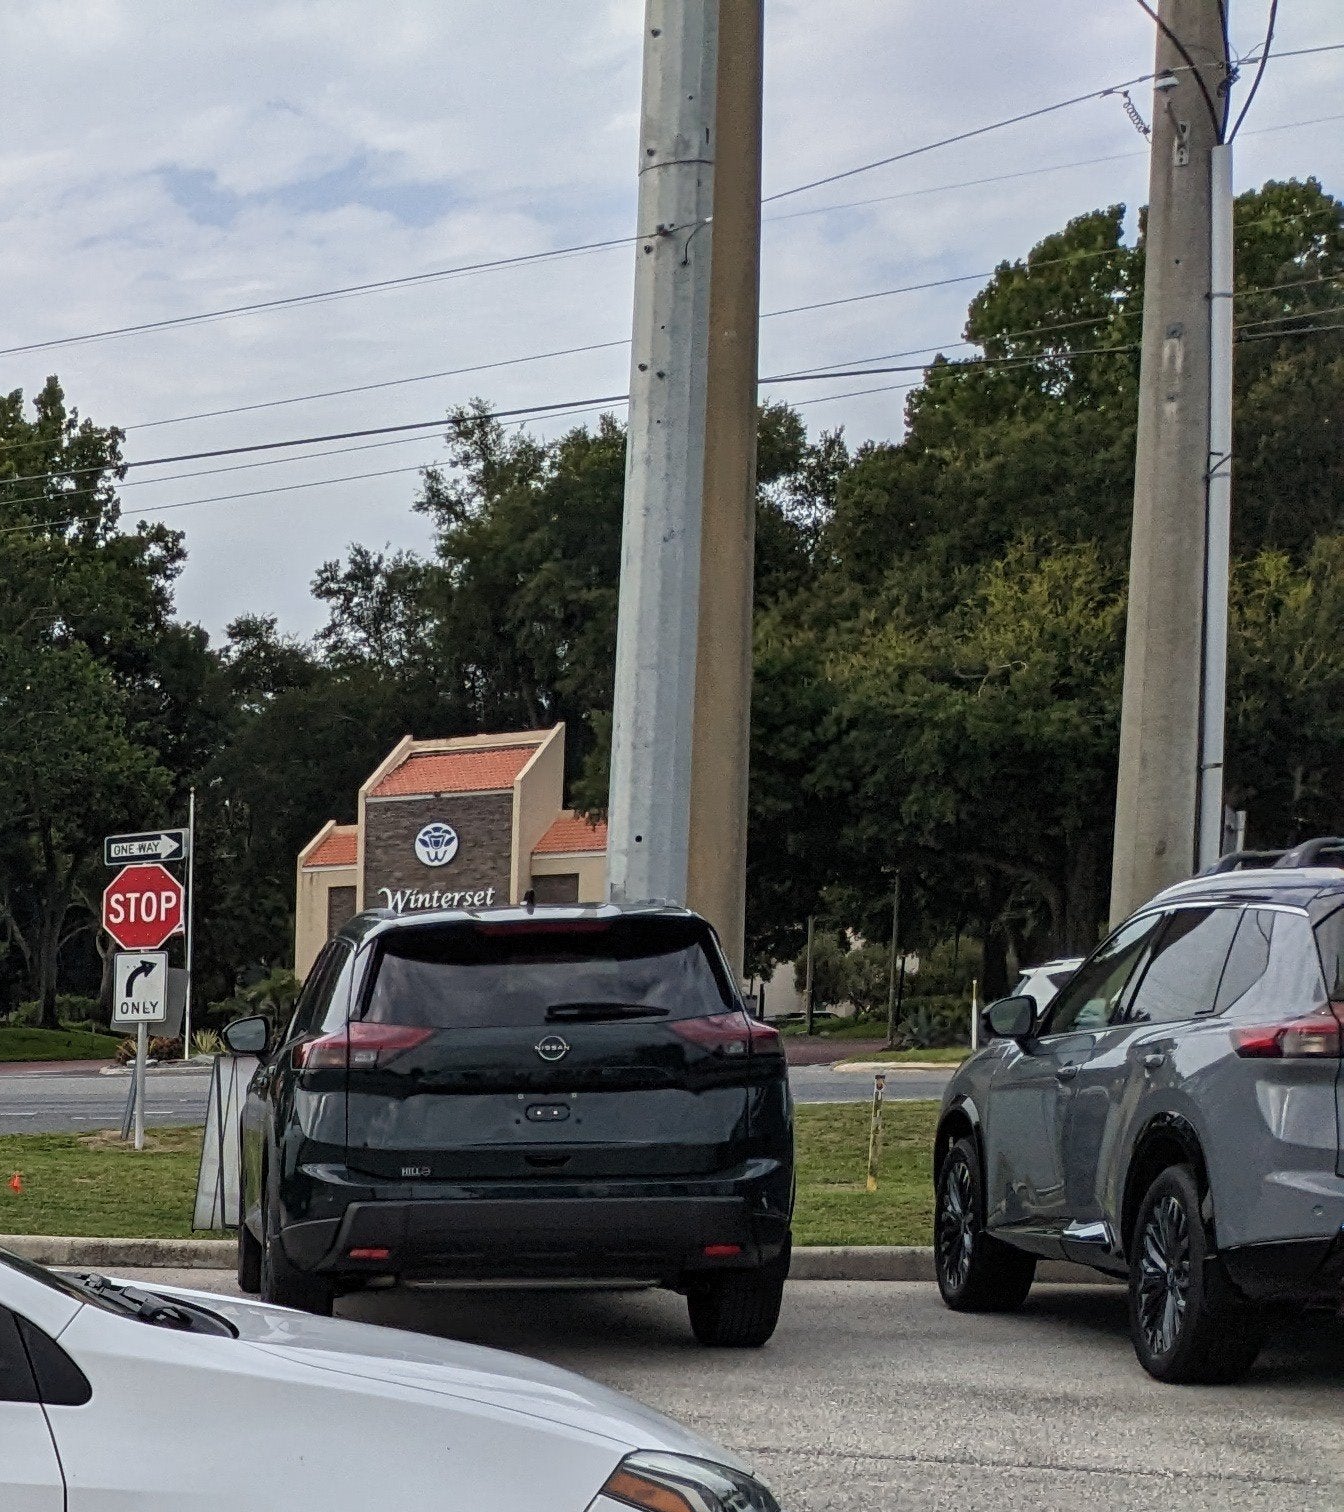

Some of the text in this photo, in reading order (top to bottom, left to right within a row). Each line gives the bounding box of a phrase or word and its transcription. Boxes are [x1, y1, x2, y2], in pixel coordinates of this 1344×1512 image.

[114, 841, 160, 856] ONE WAY
[109, 891, 177, 923] STOP
[377, 887, 496, 914] Winterset
[121, 1001, 158, 1014] ONLY
